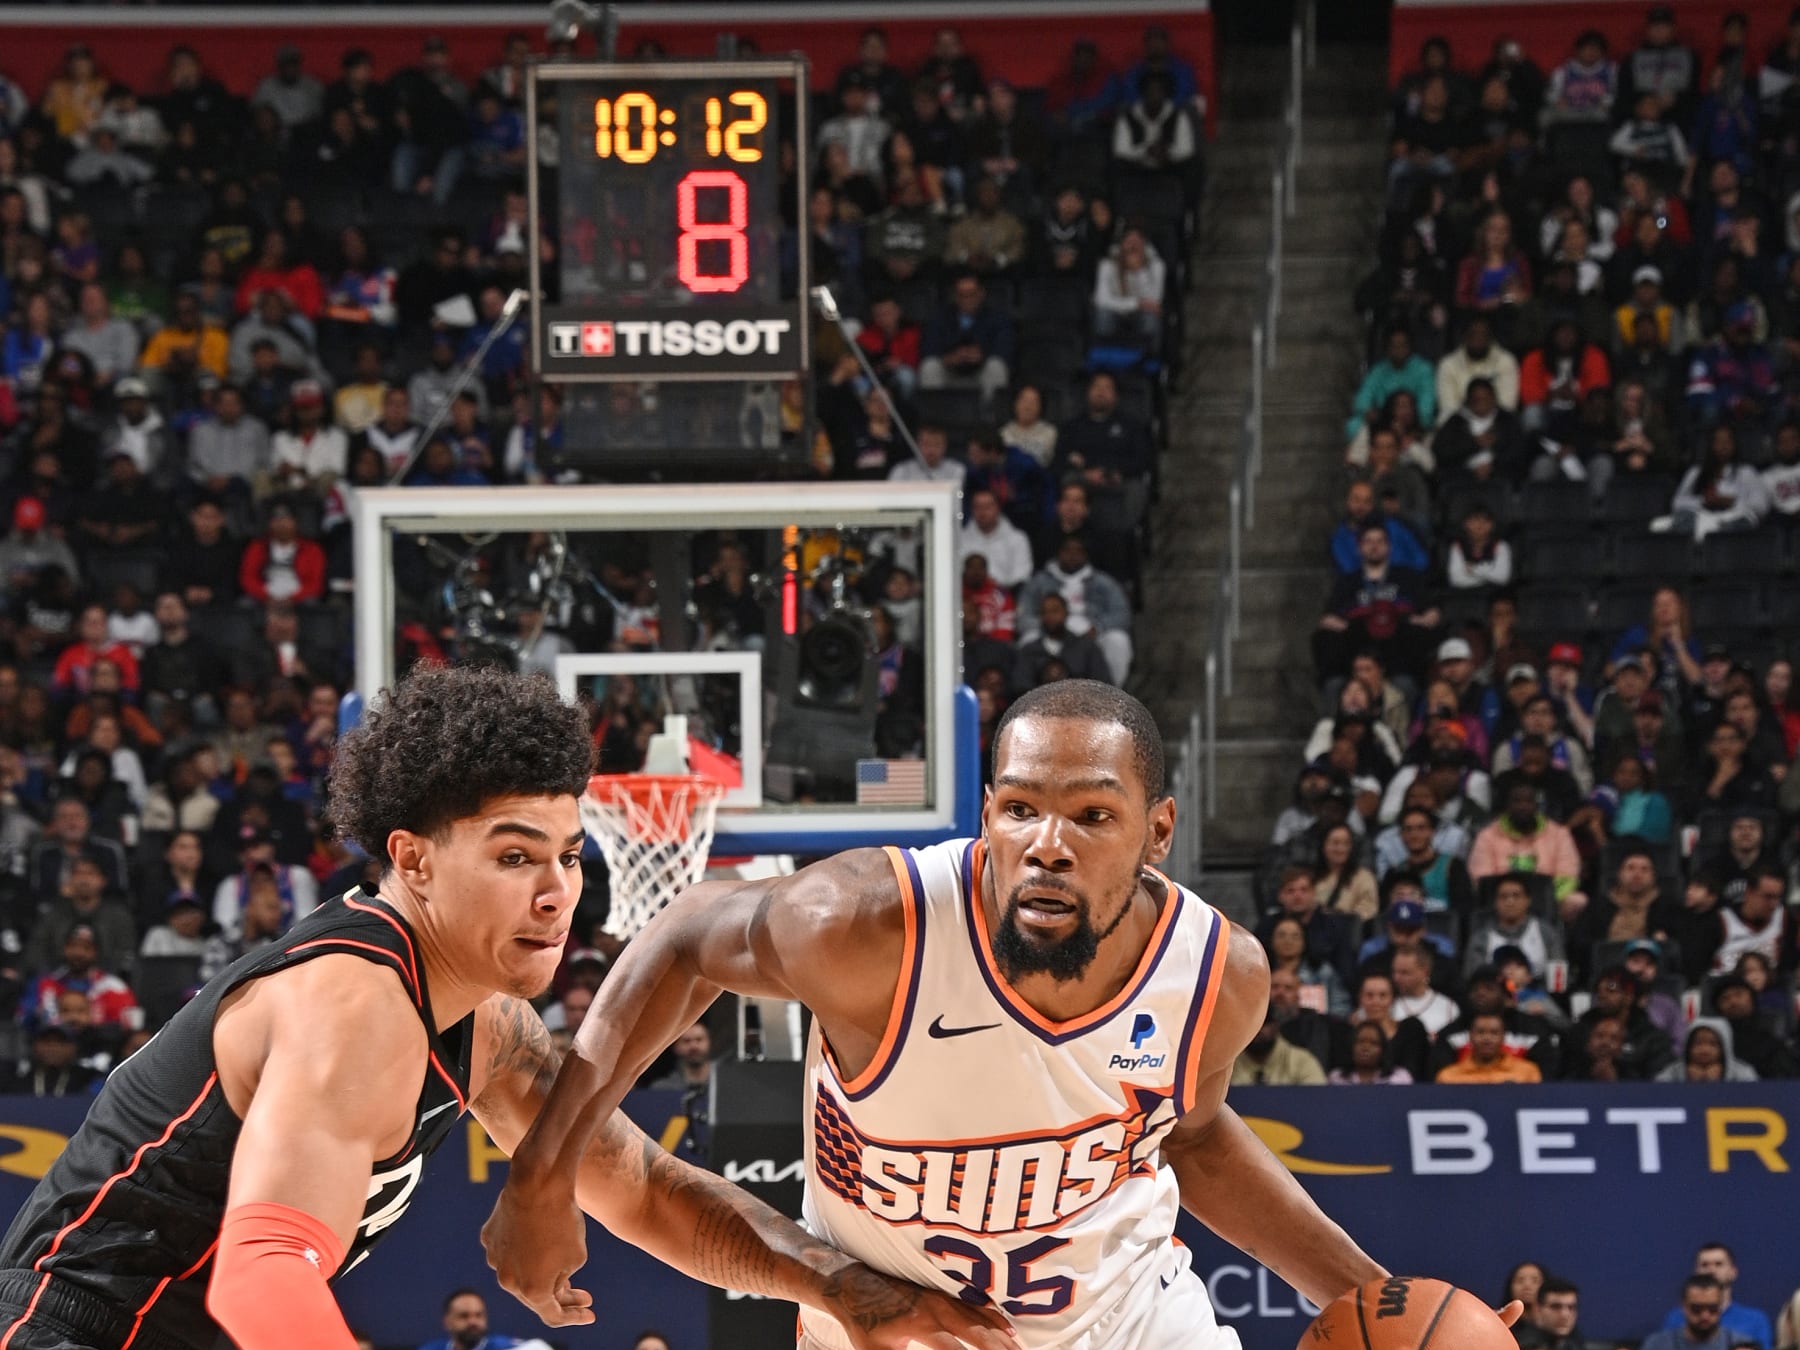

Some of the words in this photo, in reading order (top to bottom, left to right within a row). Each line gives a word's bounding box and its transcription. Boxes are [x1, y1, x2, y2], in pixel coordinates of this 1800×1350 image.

[595, 91, 768, 164] 10:12
[677, 170, 748, 293] 8
[616, 319, 790, 356] TISSOT
[1109, 1054, 1166, 1071] PayPal
[1208, 1265, 1322, 1318] CL
